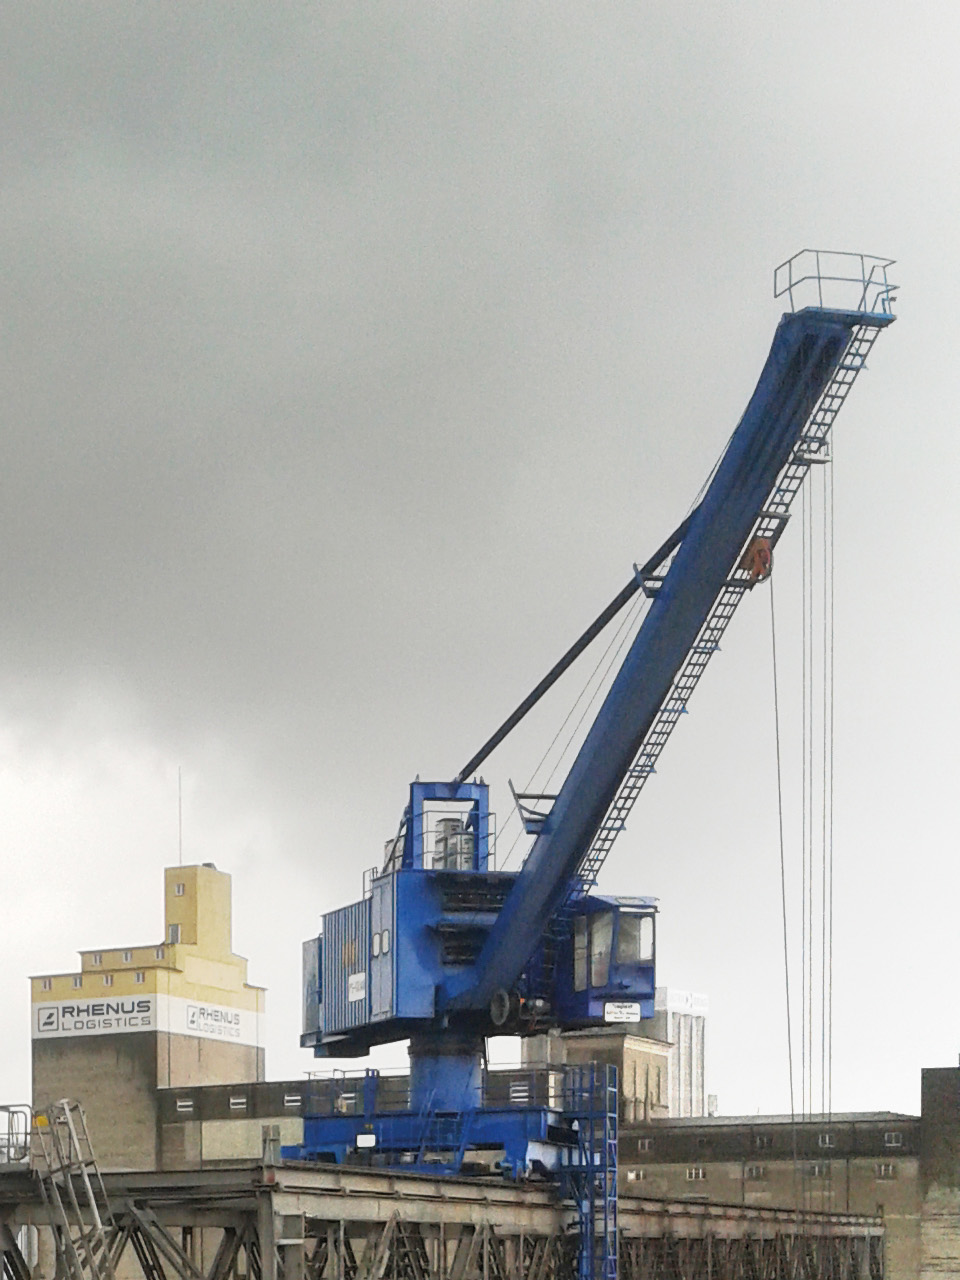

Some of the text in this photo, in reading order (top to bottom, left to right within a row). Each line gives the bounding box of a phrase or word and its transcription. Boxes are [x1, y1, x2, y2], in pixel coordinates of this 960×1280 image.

[61, 1000, 151, 1018] RHENUS
[199, 1007, 240, 1025] RHENUS
[61, 1016, 151, 1031] LOGISTICS
